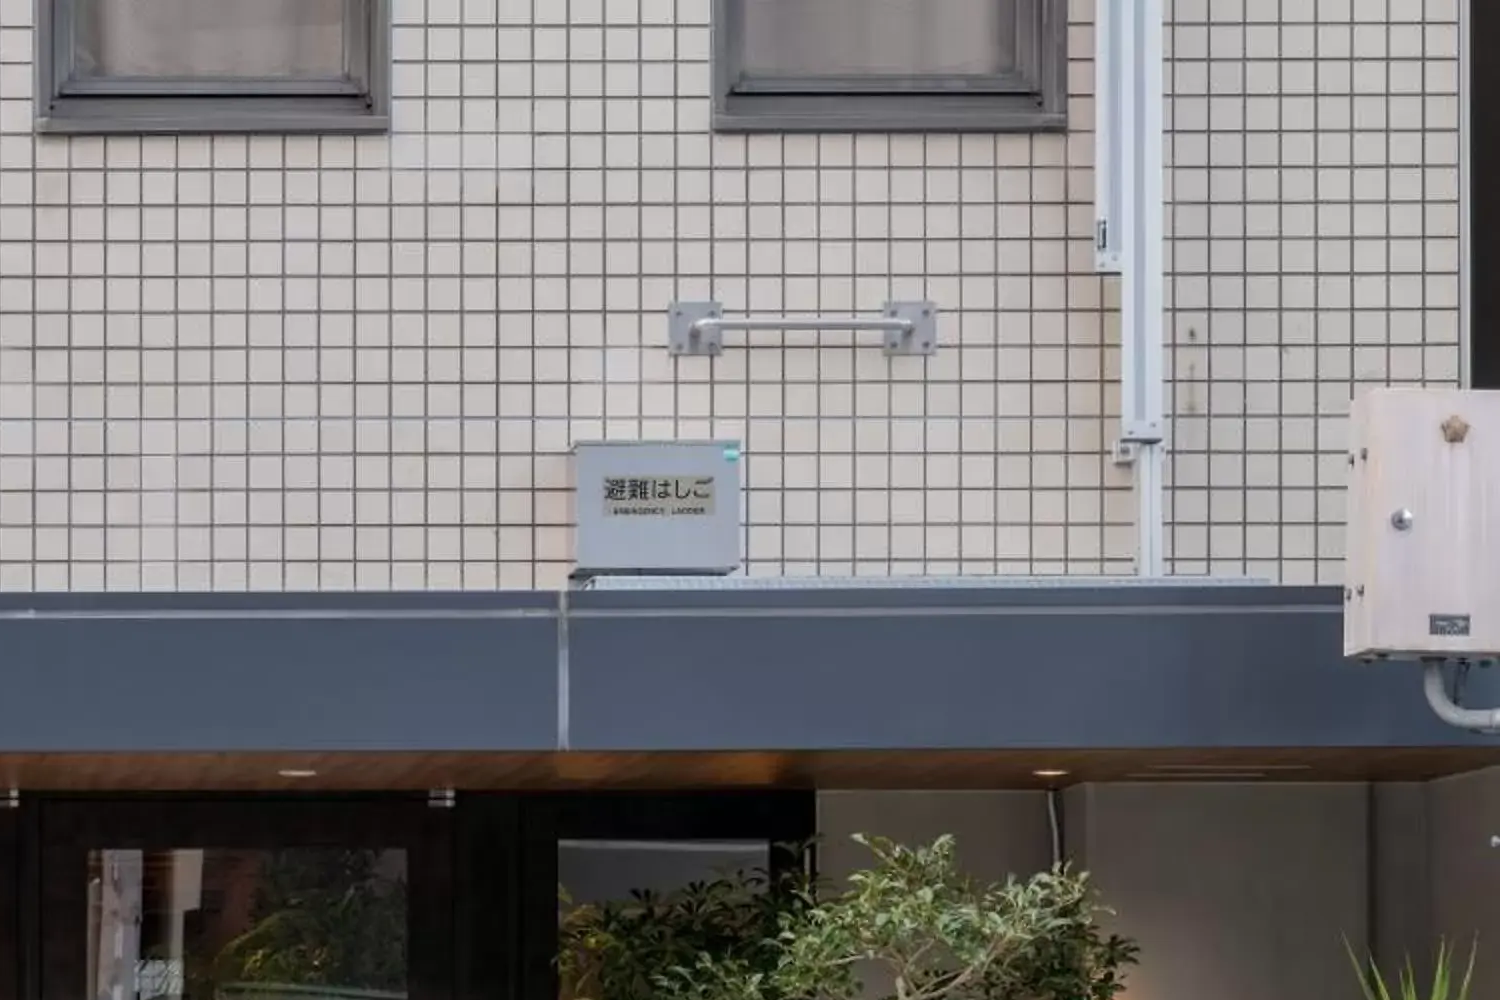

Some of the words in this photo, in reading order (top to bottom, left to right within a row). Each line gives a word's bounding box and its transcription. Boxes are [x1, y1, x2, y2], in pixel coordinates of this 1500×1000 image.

[604, 477, 714, 500] 避難はしご
